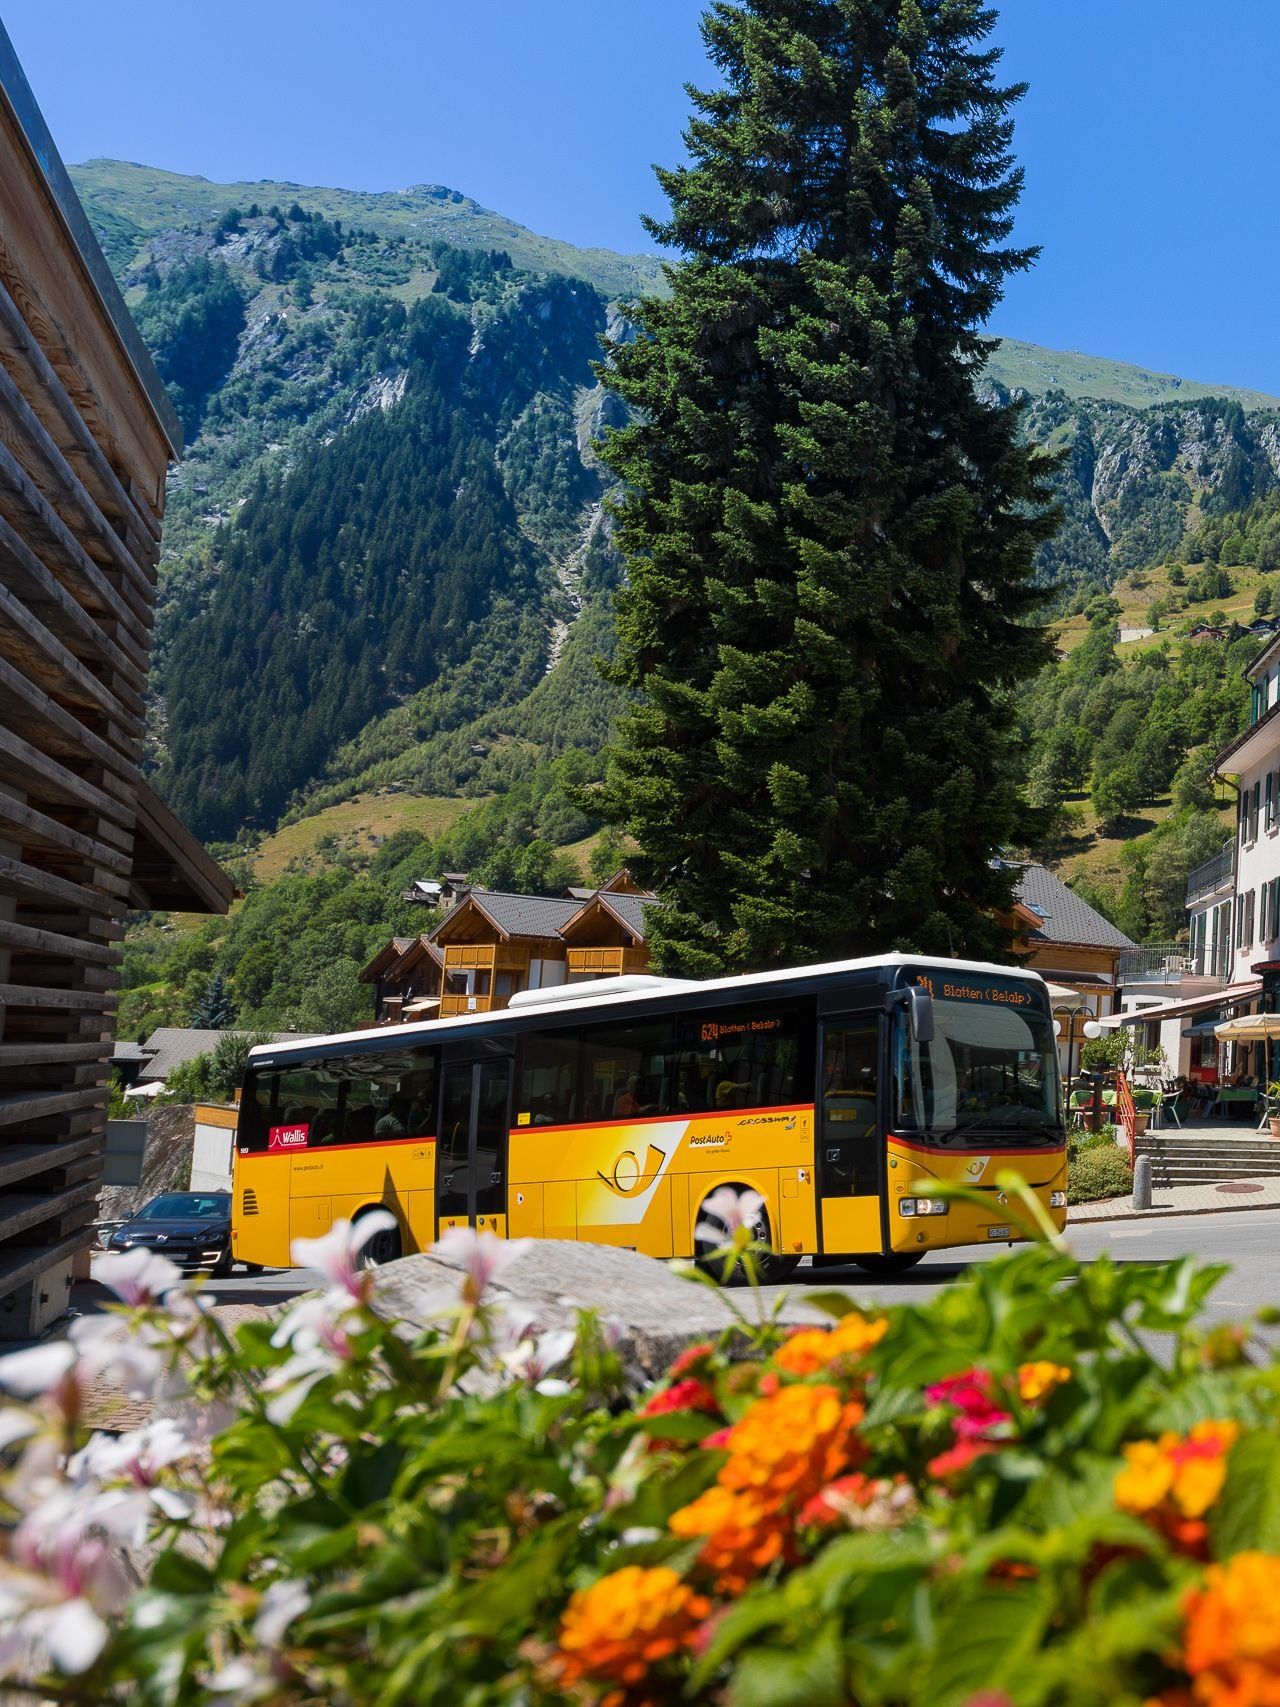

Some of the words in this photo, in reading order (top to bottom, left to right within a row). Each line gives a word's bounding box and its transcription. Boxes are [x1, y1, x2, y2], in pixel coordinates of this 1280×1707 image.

[943, 984, 983, 1000] Blatten
[701, 1024, 718, 1040] 624
[720, 1024, 745, 1034] Blatten
[282, 1129, 305, 1144] Wallis
[690, 1134, 724, 1145] PostAuto
